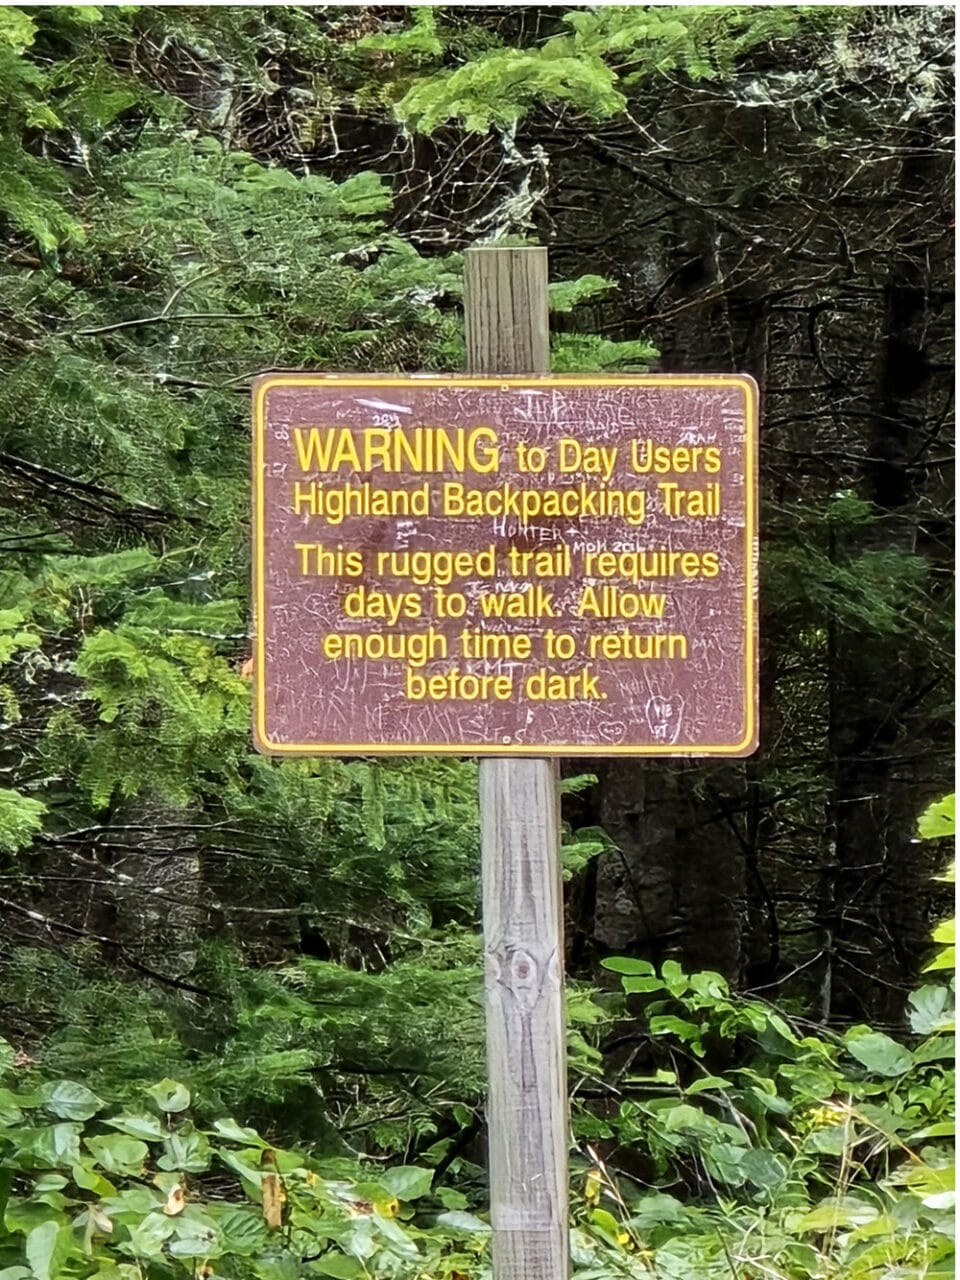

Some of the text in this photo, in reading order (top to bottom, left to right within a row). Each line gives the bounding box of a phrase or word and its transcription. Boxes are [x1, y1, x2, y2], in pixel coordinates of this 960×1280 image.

[294, 427, 722, 479] WARNING to Day Users
[294, 482, 721, 524] Highland Backpacking Trail
[295, 544, 720, 585] This rugged trail requires
[345, 586, 667, 626] days to walk. Allow
[323, 627, 687, 668] enough time to return
[406, 668, 512, 701] before
[525, 668, 608, 701] dark.
